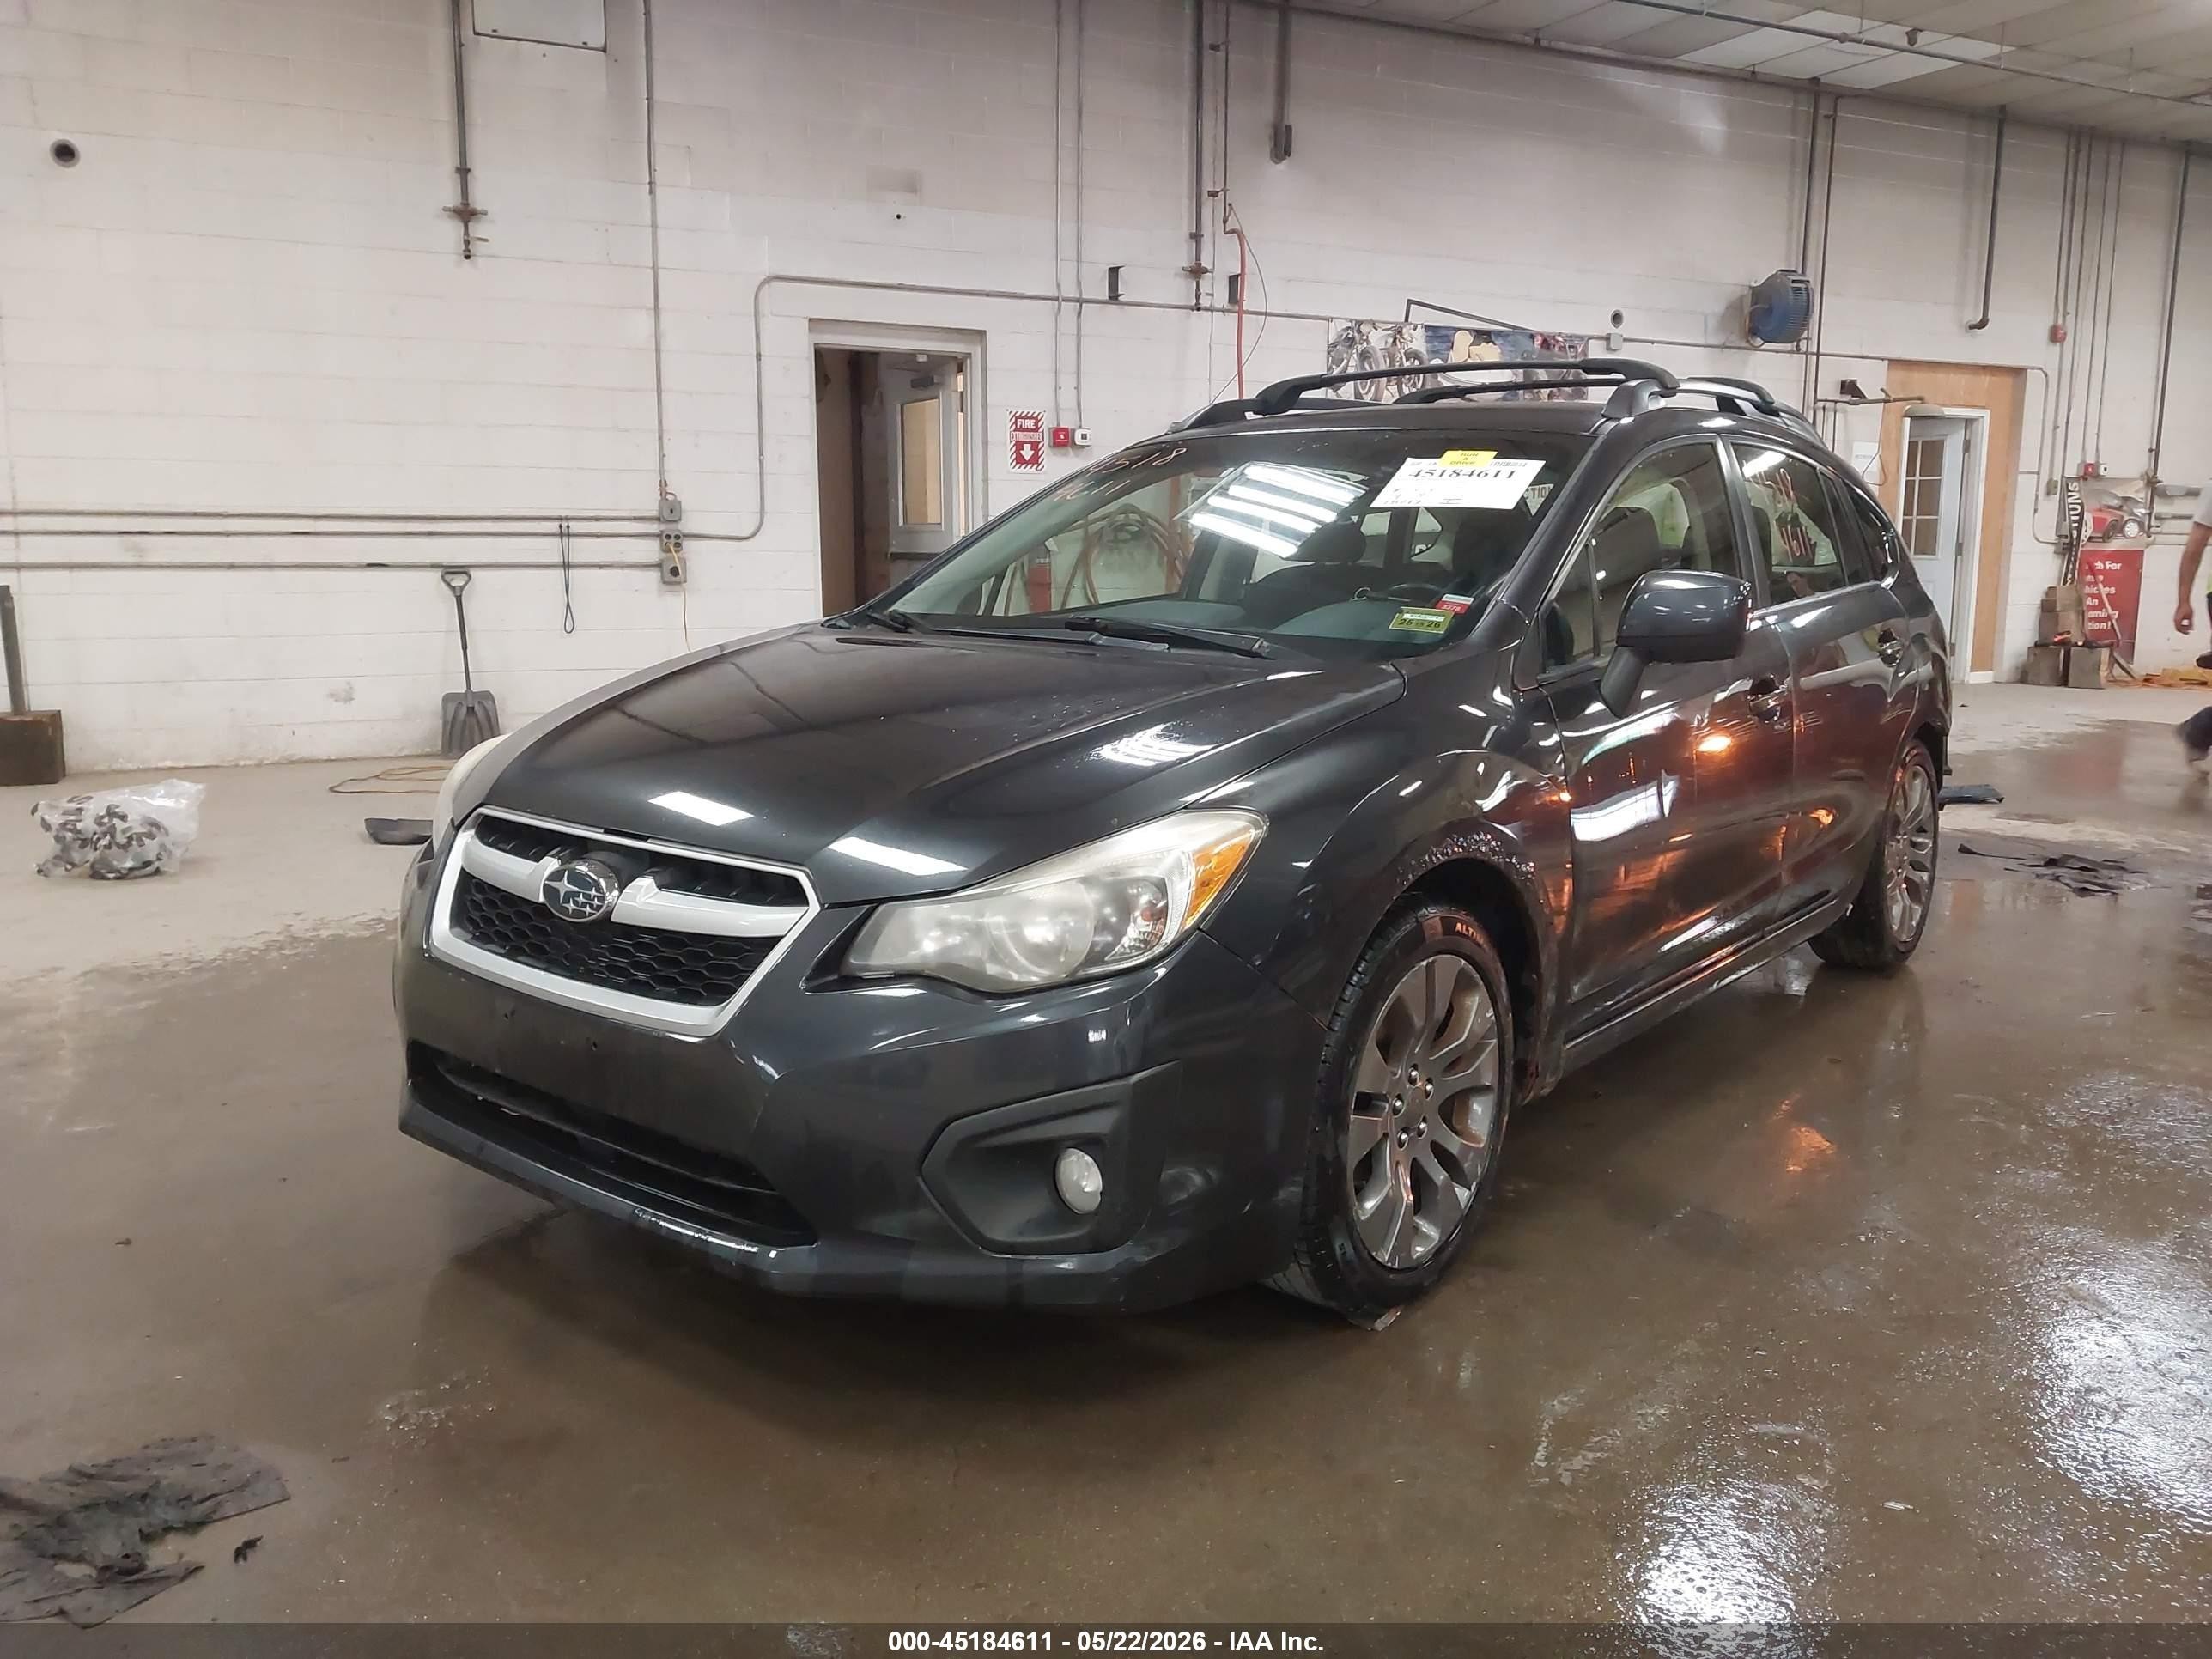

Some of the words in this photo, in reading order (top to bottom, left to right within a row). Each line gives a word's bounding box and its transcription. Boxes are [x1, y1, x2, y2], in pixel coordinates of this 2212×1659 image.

[1017, 418, 1036, 429] FIRE
[1408, 468, 1516, 480] 45184611
[2105, 560, 2122, 570] For
